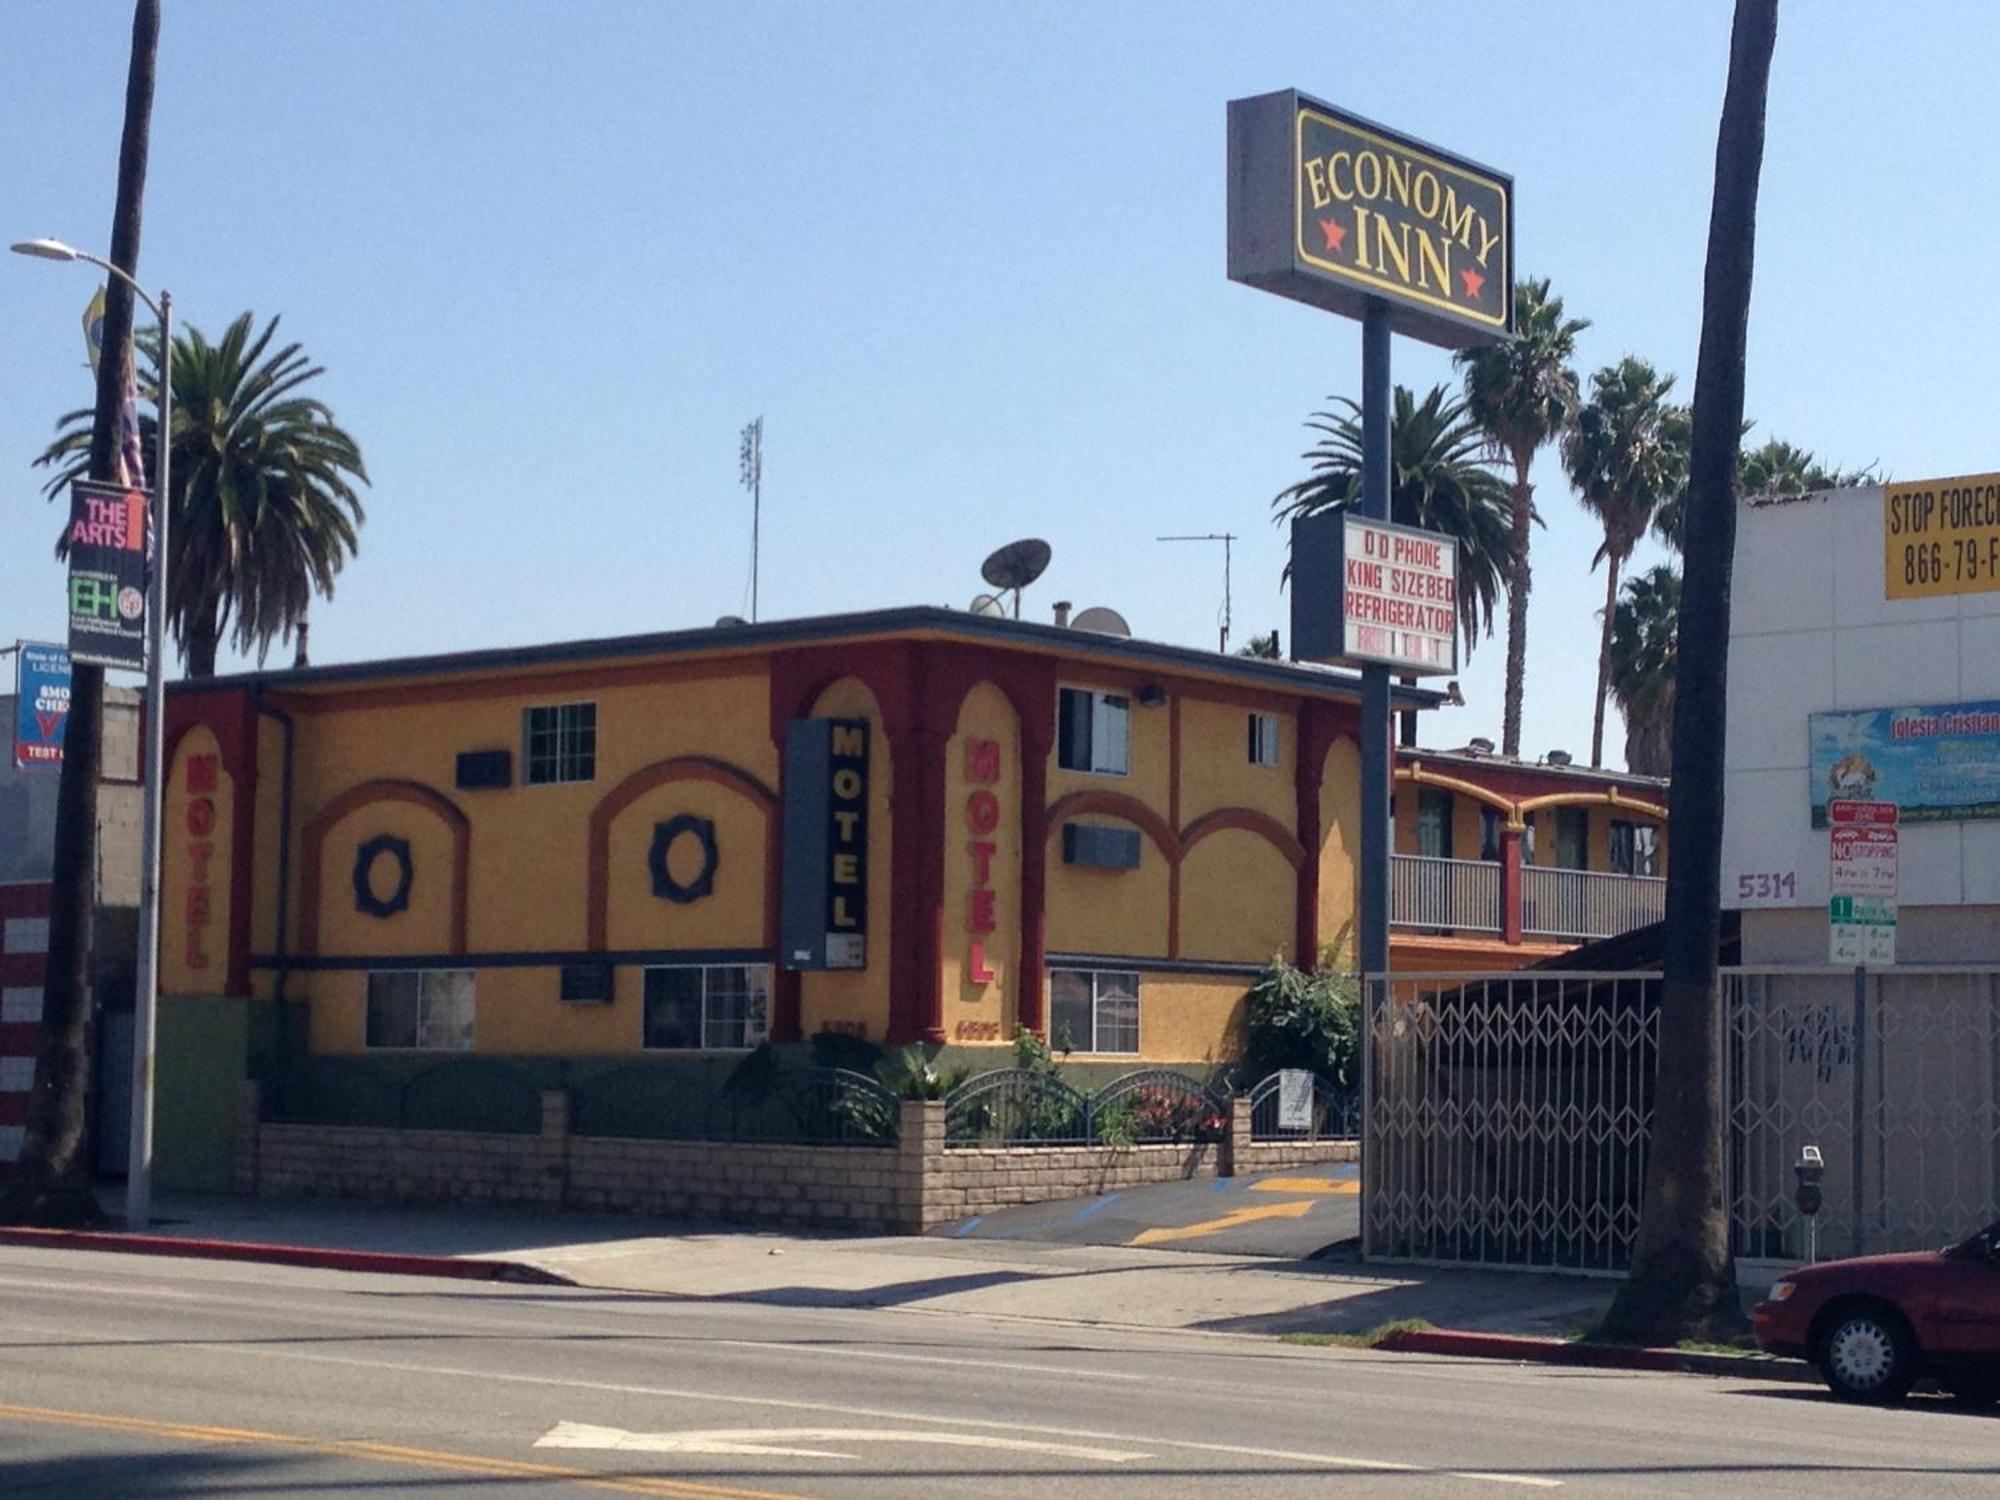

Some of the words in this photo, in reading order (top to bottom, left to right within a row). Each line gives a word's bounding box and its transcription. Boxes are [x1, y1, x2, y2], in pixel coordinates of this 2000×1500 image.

[1305, 151, 1499, 268] ECONOMY
[1353, 205, 1452, 297] INN
[85, 498, 128, 526] THE
[1891, 491, 1934, 535] STOP
[1940, 484, 2000, 531] FOREC
[72, 520, 127, 549] ARTS
[1394, 537, 1441, 570] PHONE
[1347, 559, 1382, 590] KING
[1345, 591, 1454, 635] REFRIGERATOR
[28, 745, 57, 759] TEST
[832, 726, 863, 927] MOTEL
[186, 755, 216, 970] MOTEL
[966, 741, 1001, 984] MOTEL
[1832, 842, 1853, 860] NO
[1739, 871, 1795, 898] 5314
